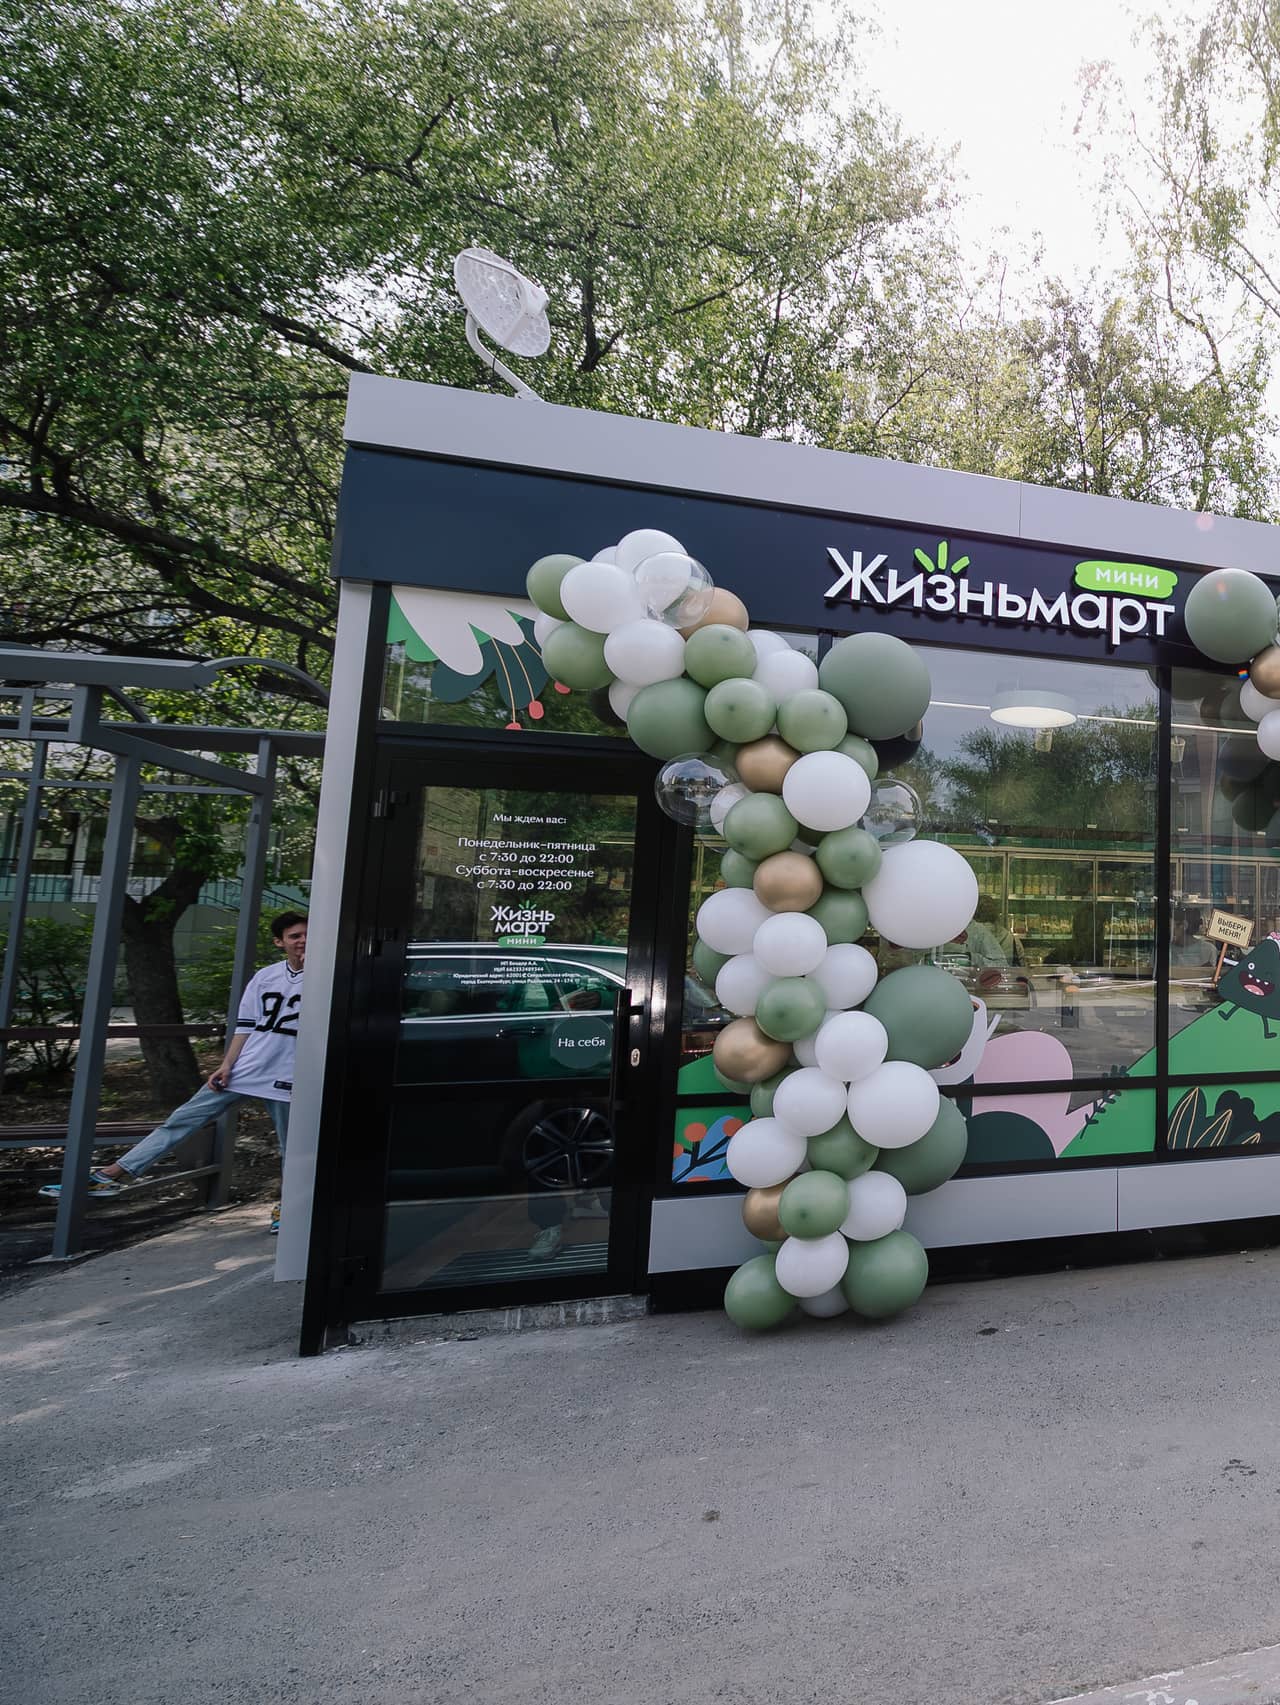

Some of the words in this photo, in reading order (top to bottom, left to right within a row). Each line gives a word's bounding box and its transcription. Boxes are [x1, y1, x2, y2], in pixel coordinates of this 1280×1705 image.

[824, 547, 1175, 645] Жизньмарт
[493, 813, 512, 822] Мы
[514, 815, 544, 824] ждем
[545, 816, 568, 825] вас:
[458, 837, 596, 852] Понедельник-пятница
[479, 854, 487, 862] с
[490, 852, 517, 862] 7:30
[519, 854, 536, 864] до
[539, 854, 574, 864] 22:00
[455, 865, 595, 878] Суббота-воскресенье
[476, 881, 484, 889] с
[487, 879, 515, 890] 7:30
[517, 882, 534, 891] до
[537, 880, 572, 891] 22:00
[490, 905, 556, 921] Жизнь
[494, 921, 550, 937] март
[1217, 917, 1247, 932] ВЫБЕРИ
[1218, 927, 1242, 940] МЕНЯ!
[255, 991, 301, 1036] 92
[558, 1038, 575, 1048] На
[577, 1036, 606, 1047] себя
